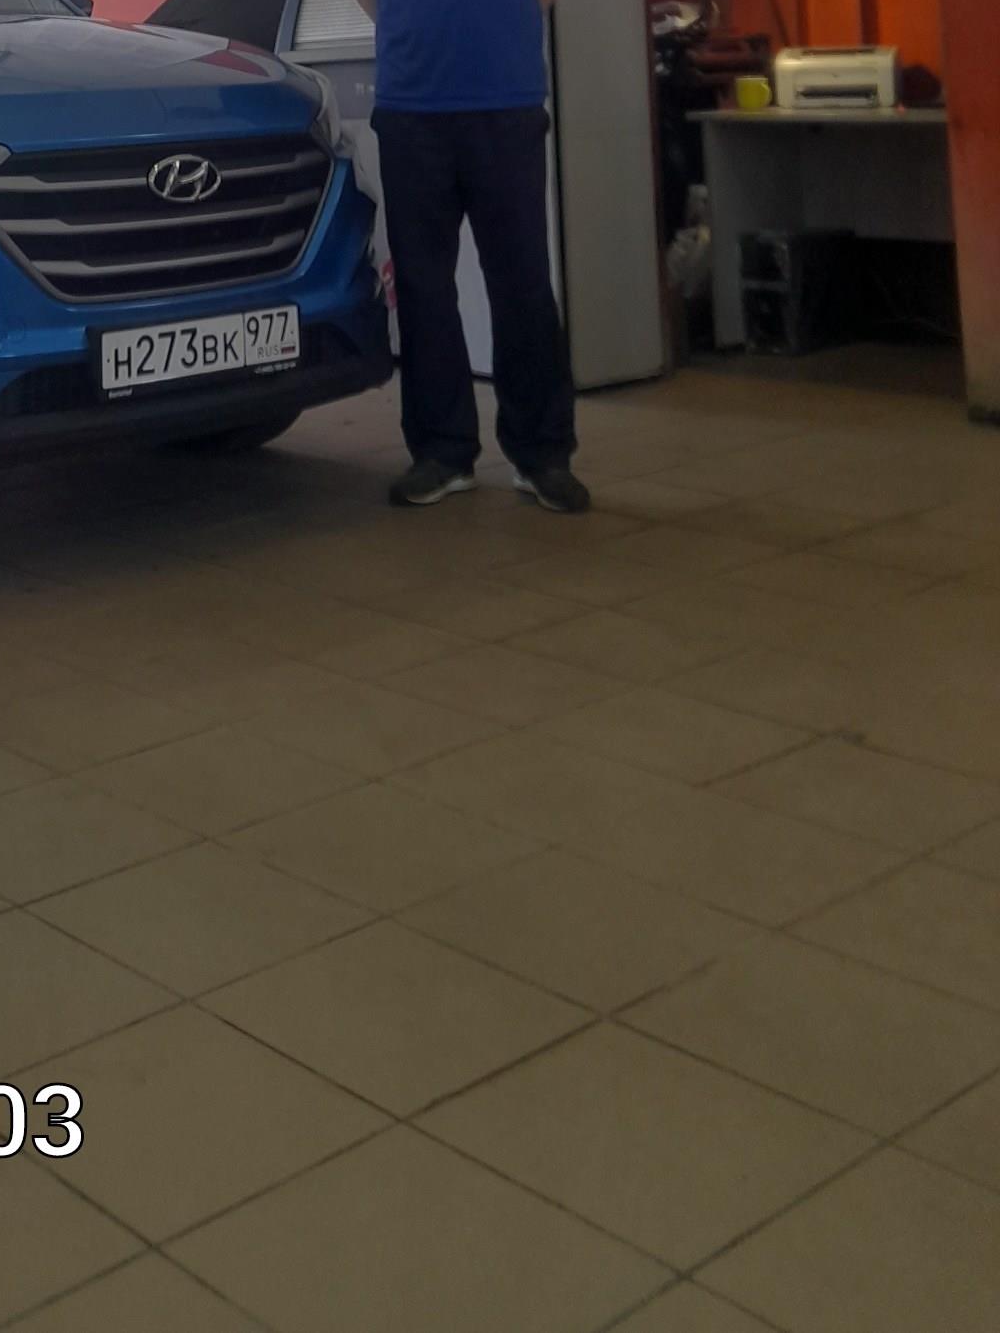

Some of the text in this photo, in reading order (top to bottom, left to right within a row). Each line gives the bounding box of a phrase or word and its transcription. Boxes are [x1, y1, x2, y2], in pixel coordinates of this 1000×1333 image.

[246, 311, 289, 347] 977
[113, 327, 240, 381] Н273ВК
[256, 344, 280, 358] RUS
